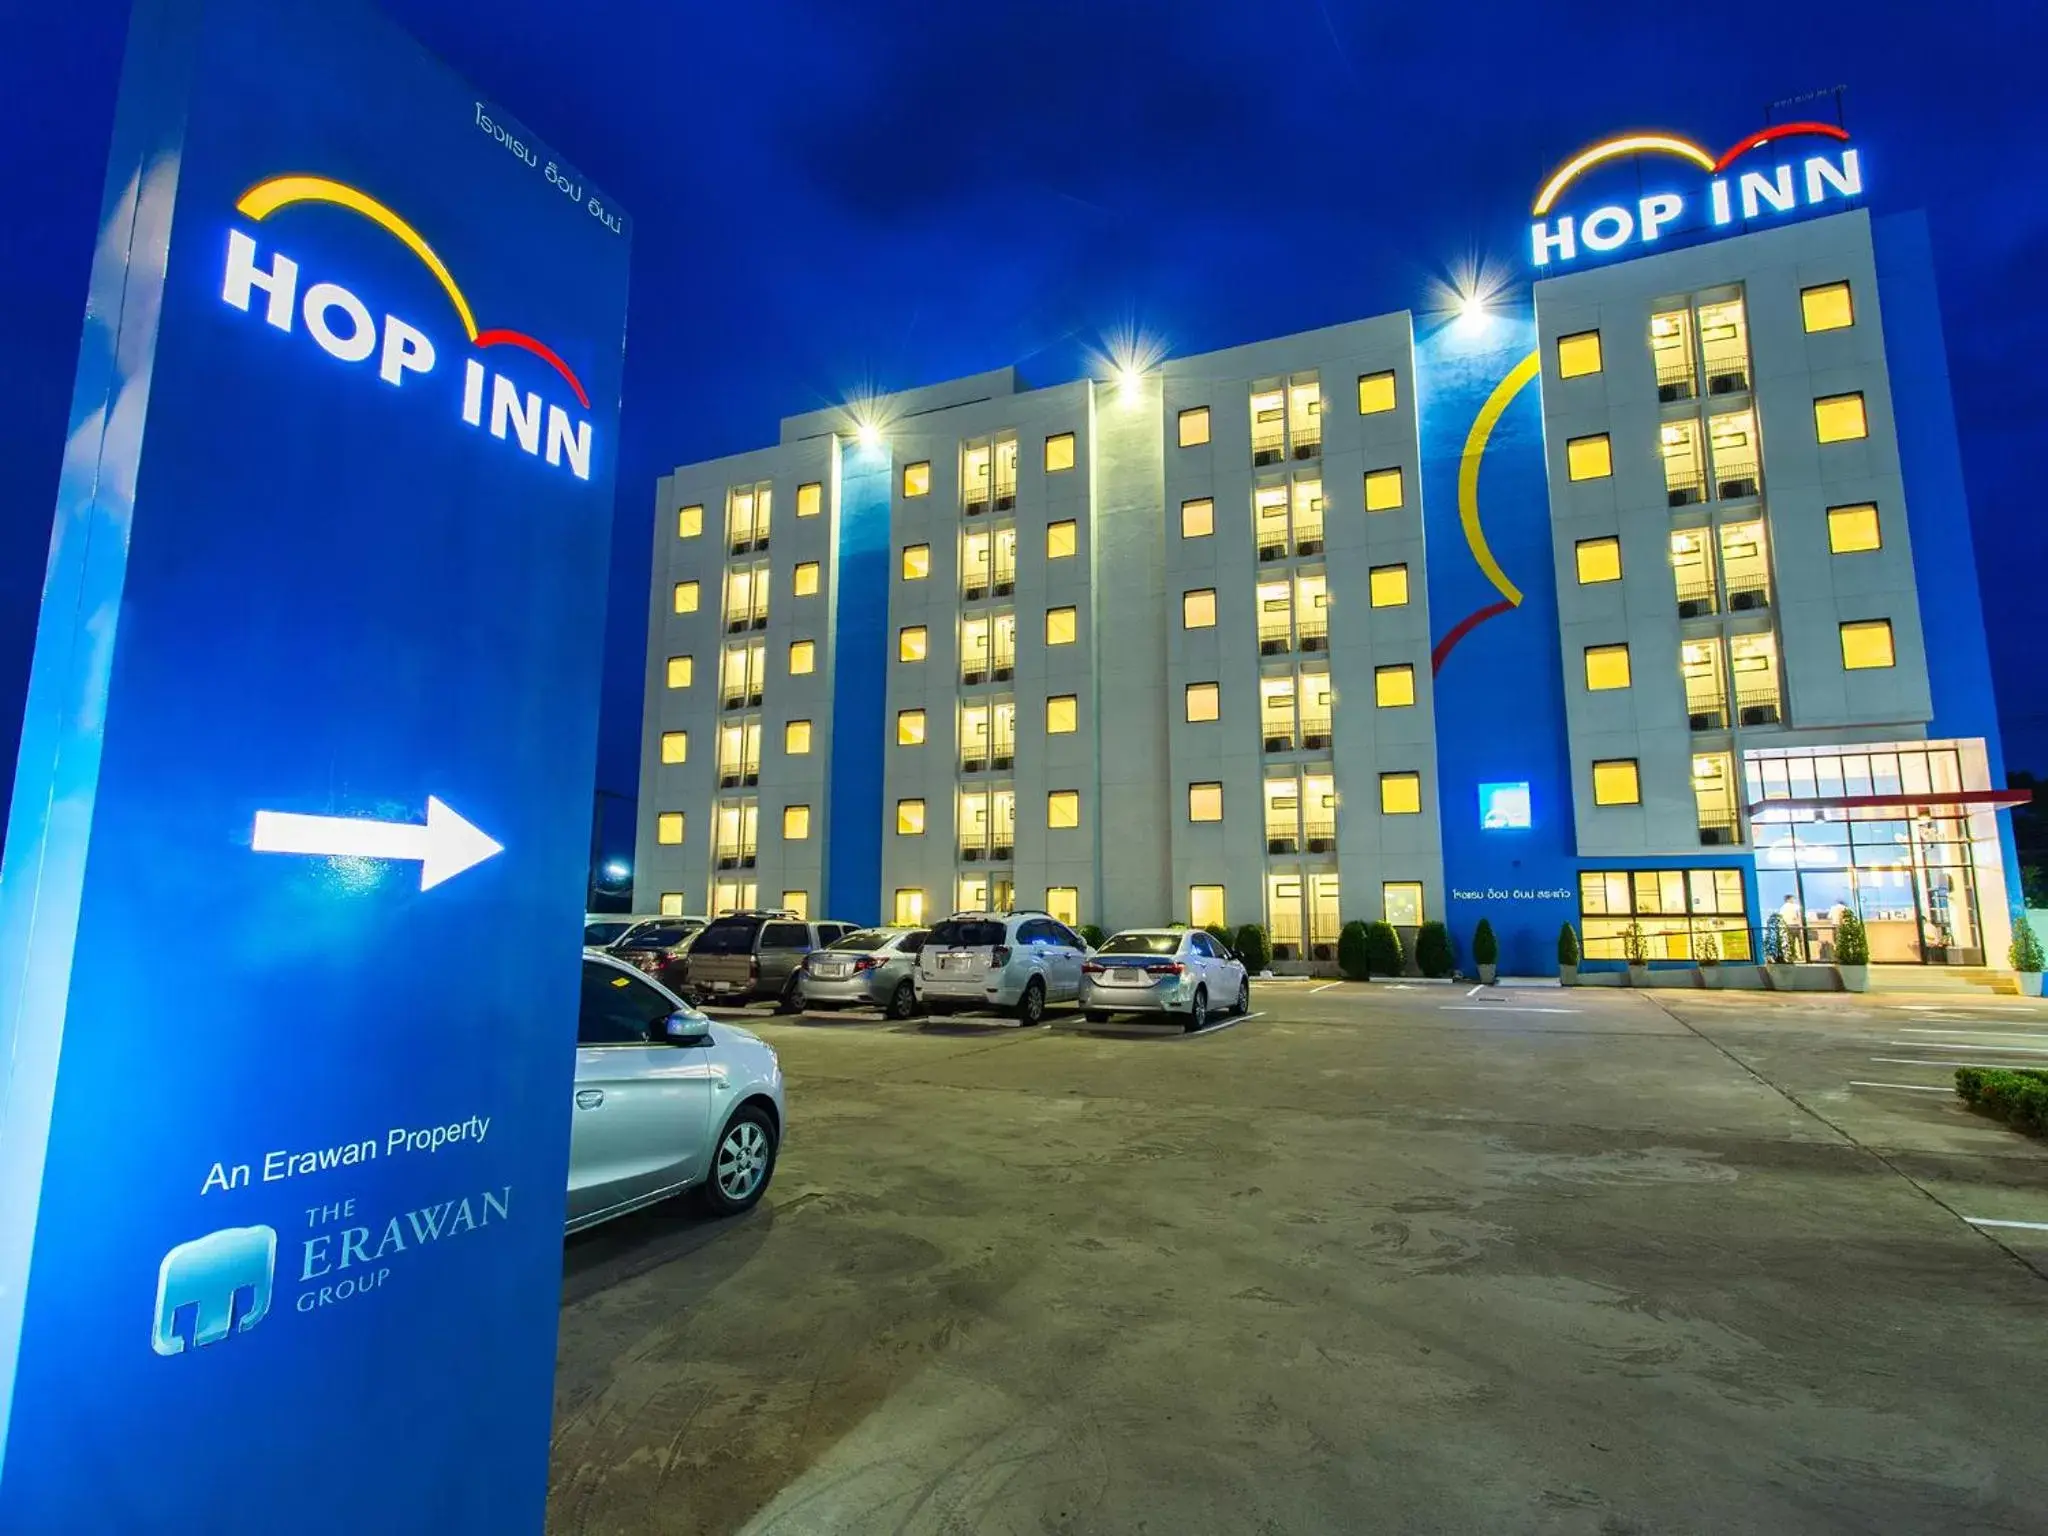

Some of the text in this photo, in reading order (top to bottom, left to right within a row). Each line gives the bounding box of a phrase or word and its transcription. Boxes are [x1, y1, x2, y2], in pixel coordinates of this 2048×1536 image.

[475, 102, 538, 168] โรงแรม
[1531, 149, 1863, 266] HOP INN
[221, 228, 593, 481] HOP INN
[201, 1114, 491, 1196] An Erawan Property
[298, 1186, 513, 1283] ERAWAN
[305, 1198, 357, 1229] THE
[296, 1268, 392, 1313] GROUP
